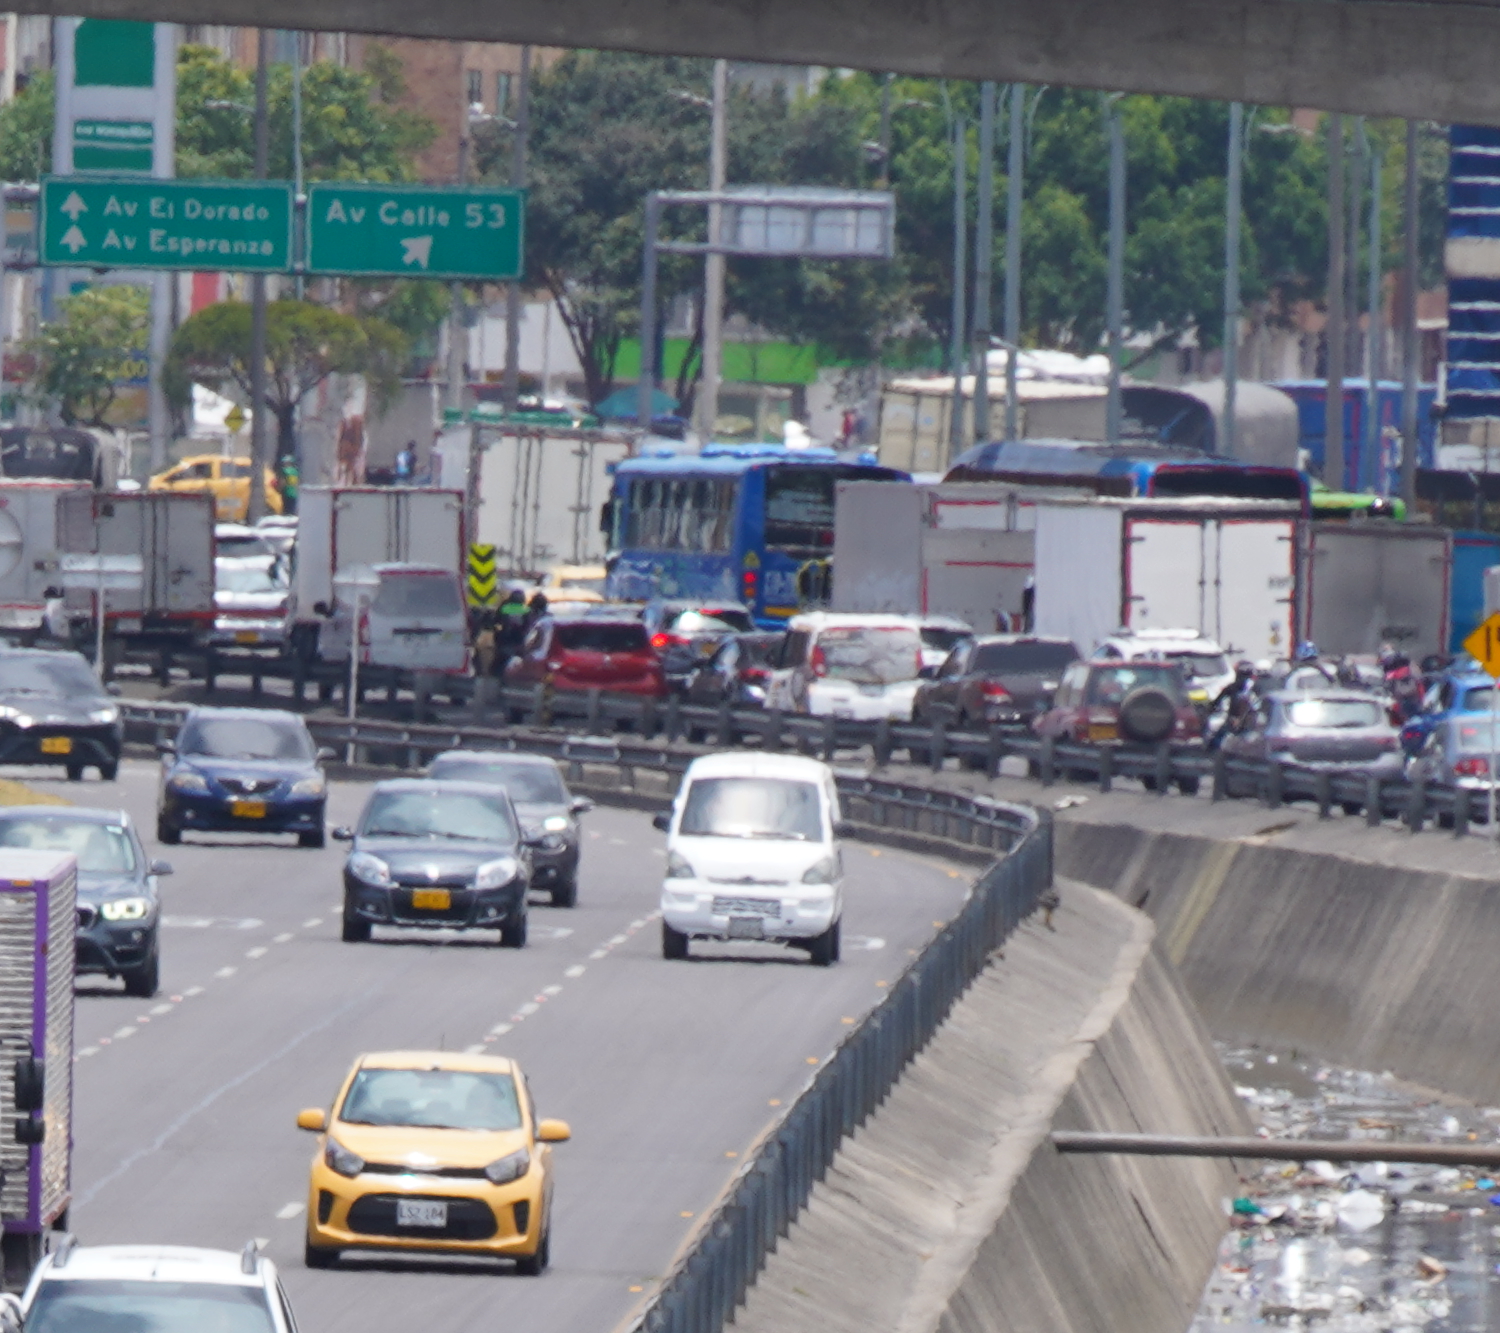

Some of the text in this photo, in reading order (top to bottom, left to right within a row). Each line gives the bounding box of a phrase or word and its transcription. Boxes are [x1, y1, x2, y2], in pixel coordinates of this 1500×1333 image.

[103, 195, 270, 221] Av El Dorado
[326, 198, 506, 229] Av Calle 53
[102, 228, 274, 257] Av Esperanza
